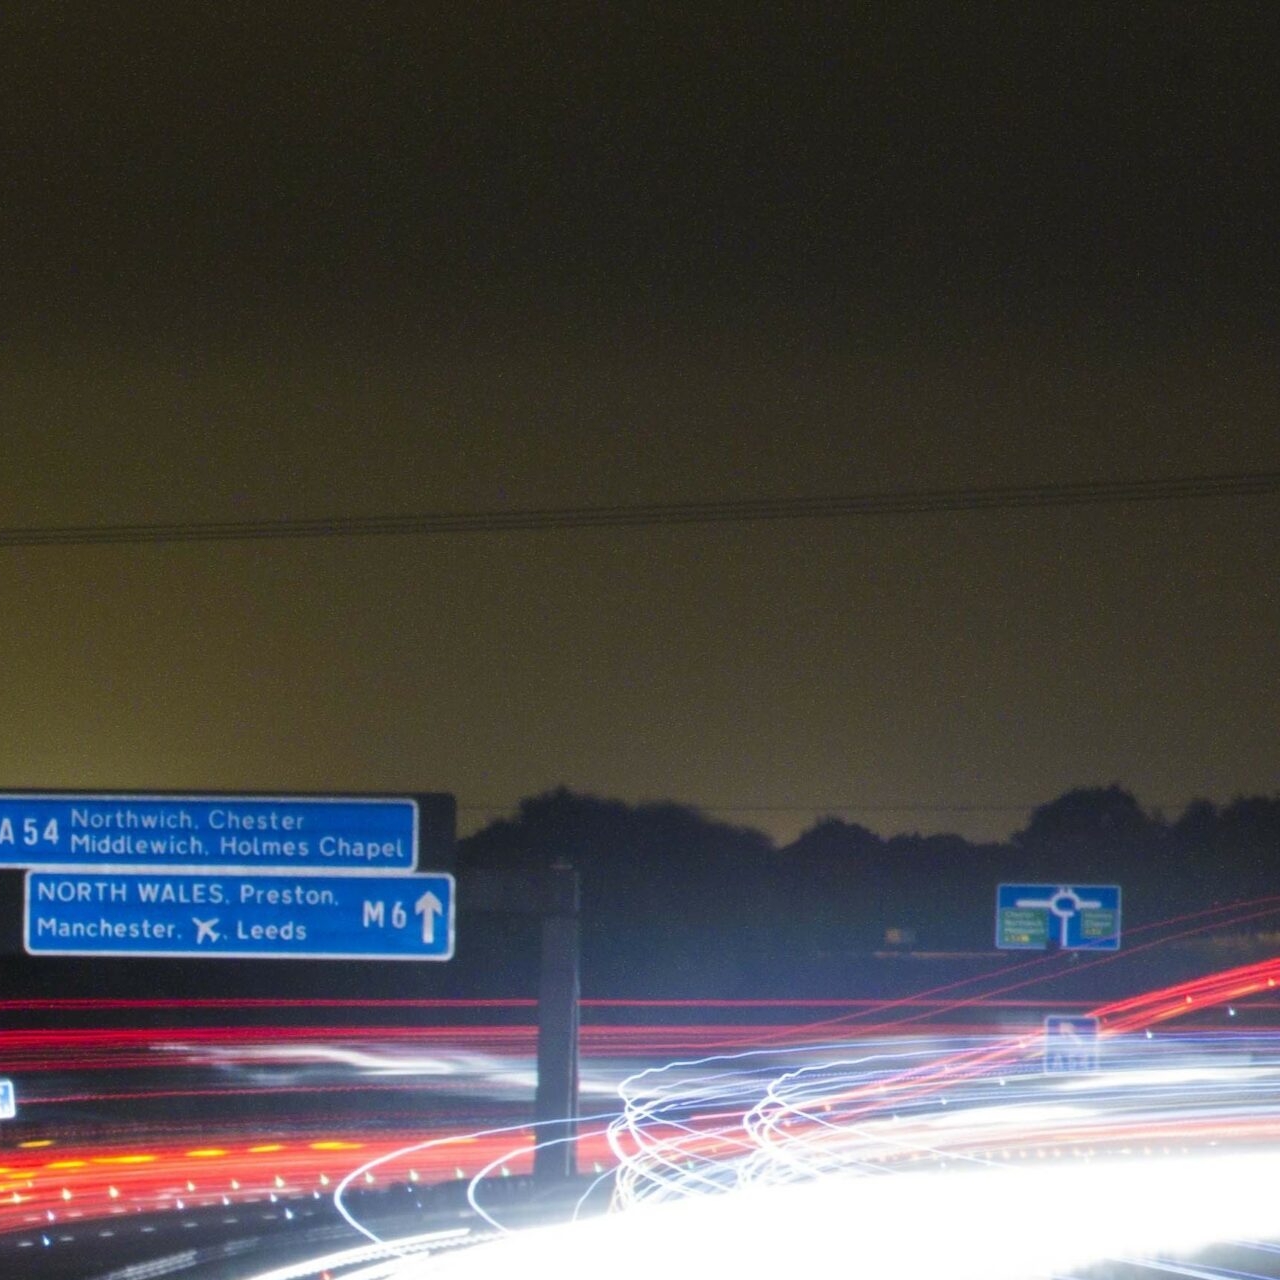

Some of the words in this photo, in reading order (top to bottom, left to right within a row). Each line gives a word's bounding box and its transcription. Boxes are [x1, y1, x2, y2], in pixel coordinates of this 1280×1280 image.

[208, 809, 305, 830] Chester
[220, 836, 309, 857] Holmes
[320, 836, 404, 861] Chapel
[37, 882, 127, 903] NORTH
[237, 920, 307, 941] Leeds
